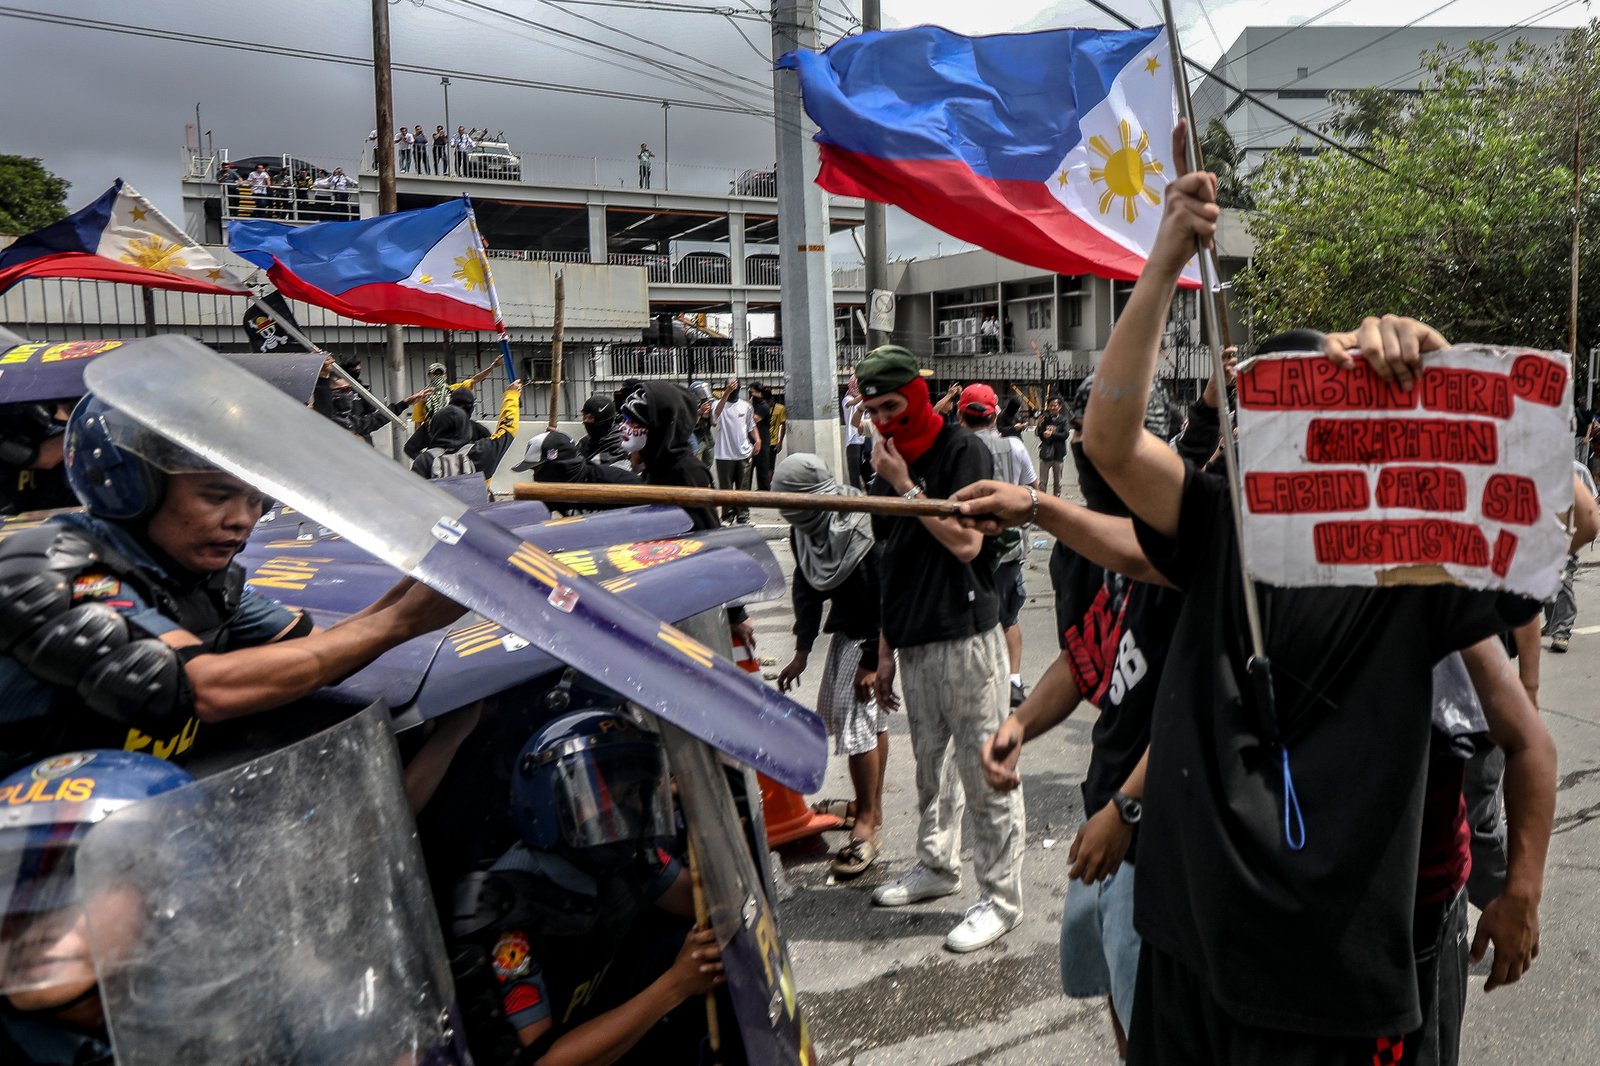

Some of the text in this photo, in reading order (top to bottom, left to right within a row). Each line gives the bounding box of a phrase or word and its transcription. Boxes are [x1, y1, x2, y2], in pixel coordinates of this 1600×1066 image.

[1241, 354, 1566, 419] LABAN PARA SA
[1308, 420, 1497, 464] KARAPATAN
[1245, 470, 1539, 525] LABAN PARA SA
